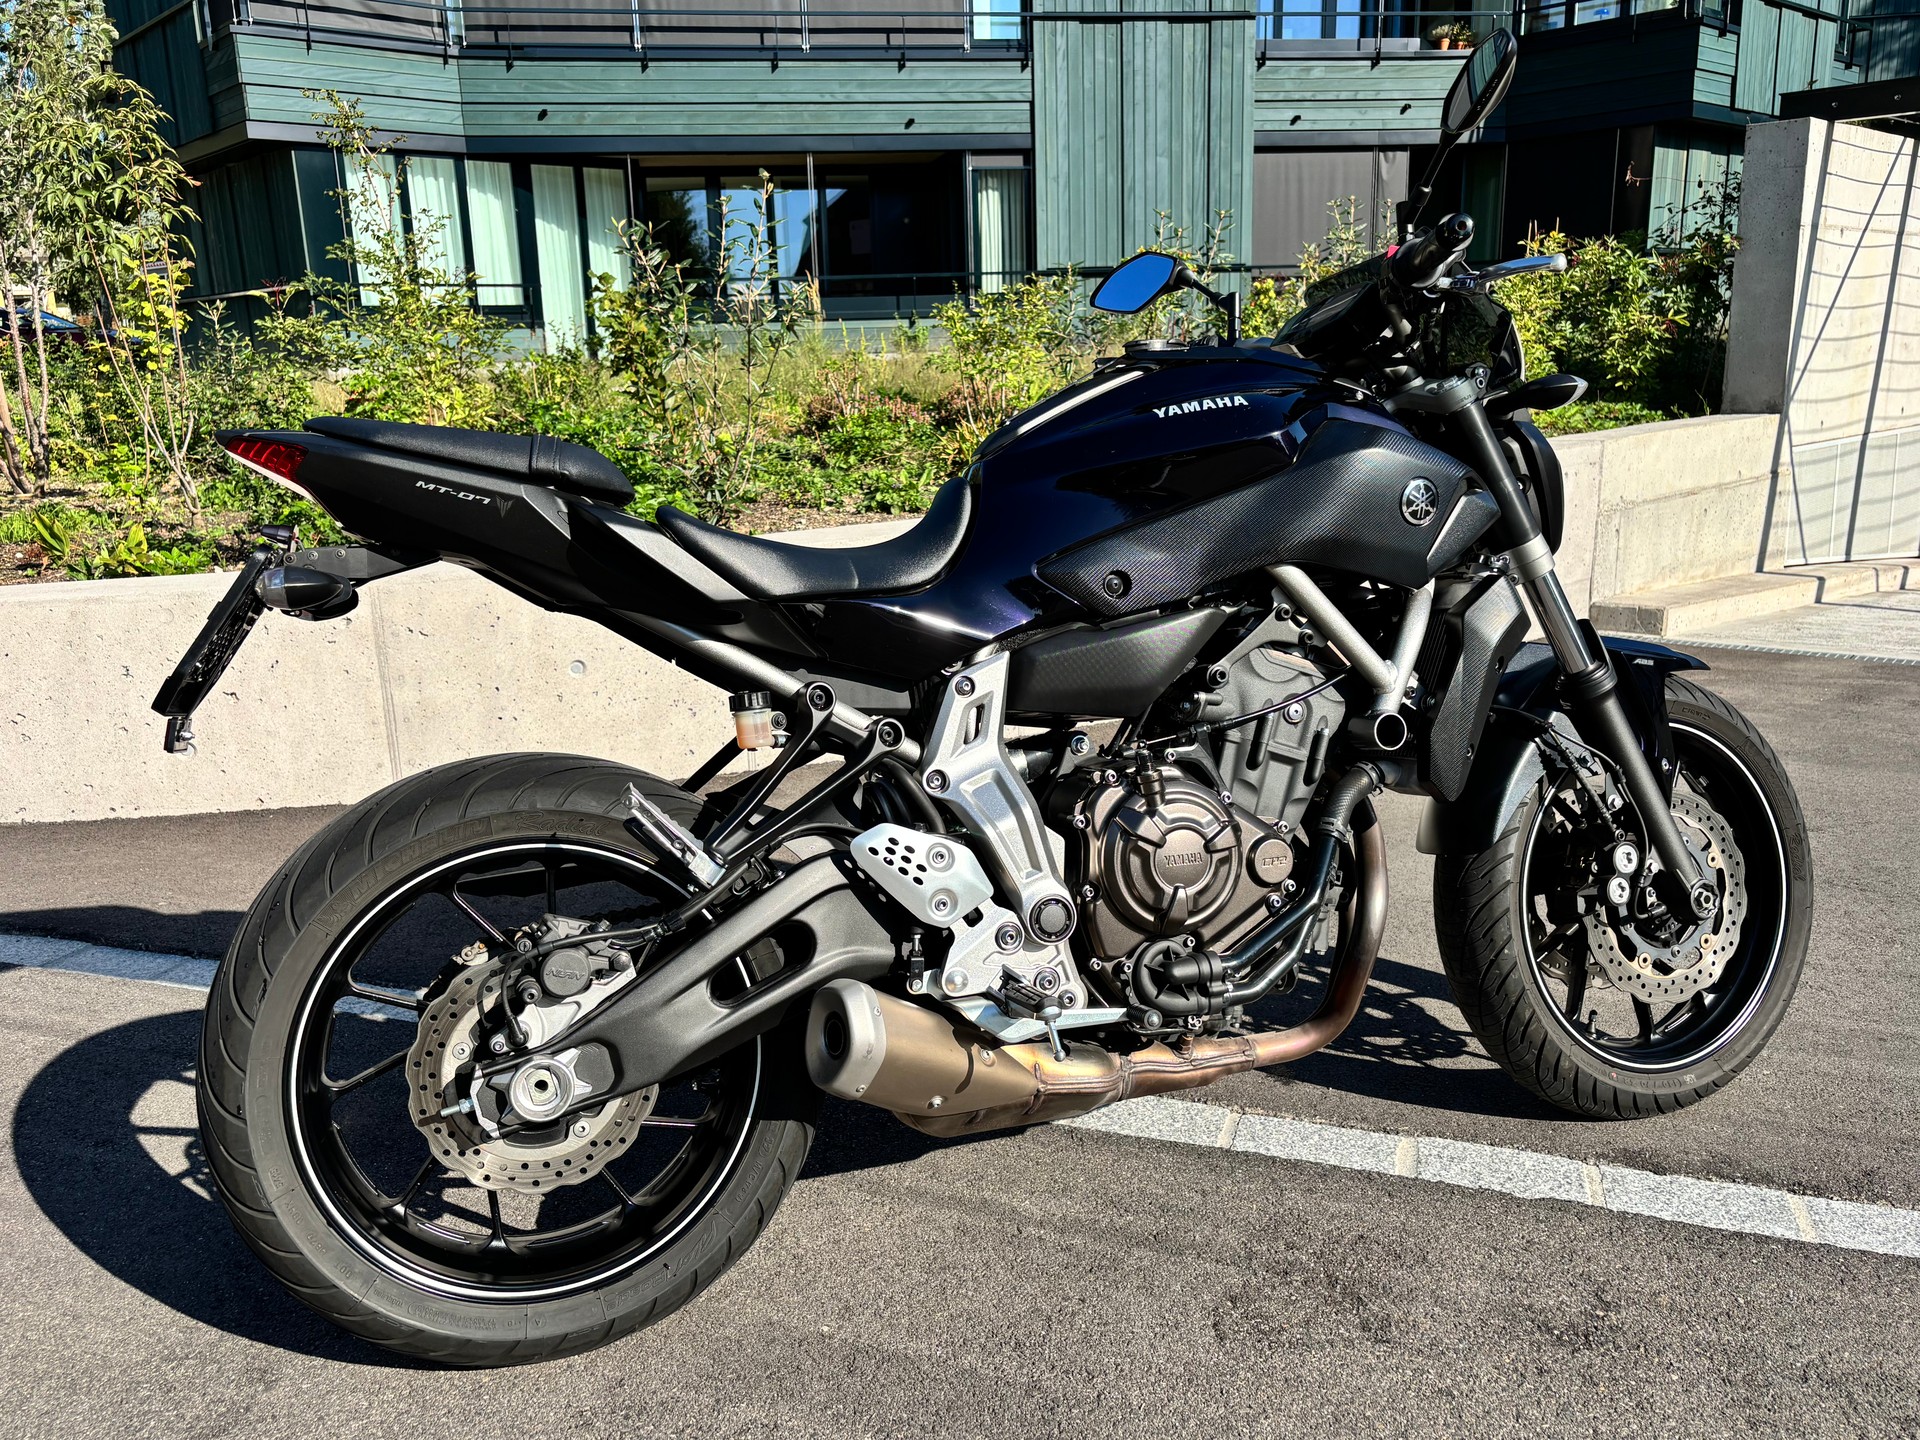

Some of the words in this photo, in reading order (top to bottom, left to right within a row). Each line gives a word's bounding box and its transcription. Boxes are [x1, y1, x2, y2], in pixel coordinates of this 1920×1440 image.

[1152, 395, 1249, 418] YAMAHA
[415, 480, 491, 505] MT-07
[1632, 658, 1655, 666] ABS
[515, 811, 610, 836] Radial
[1163, 852, 1203, 867] YAMAHA
[1262, 856, 1287, 867] CP2
